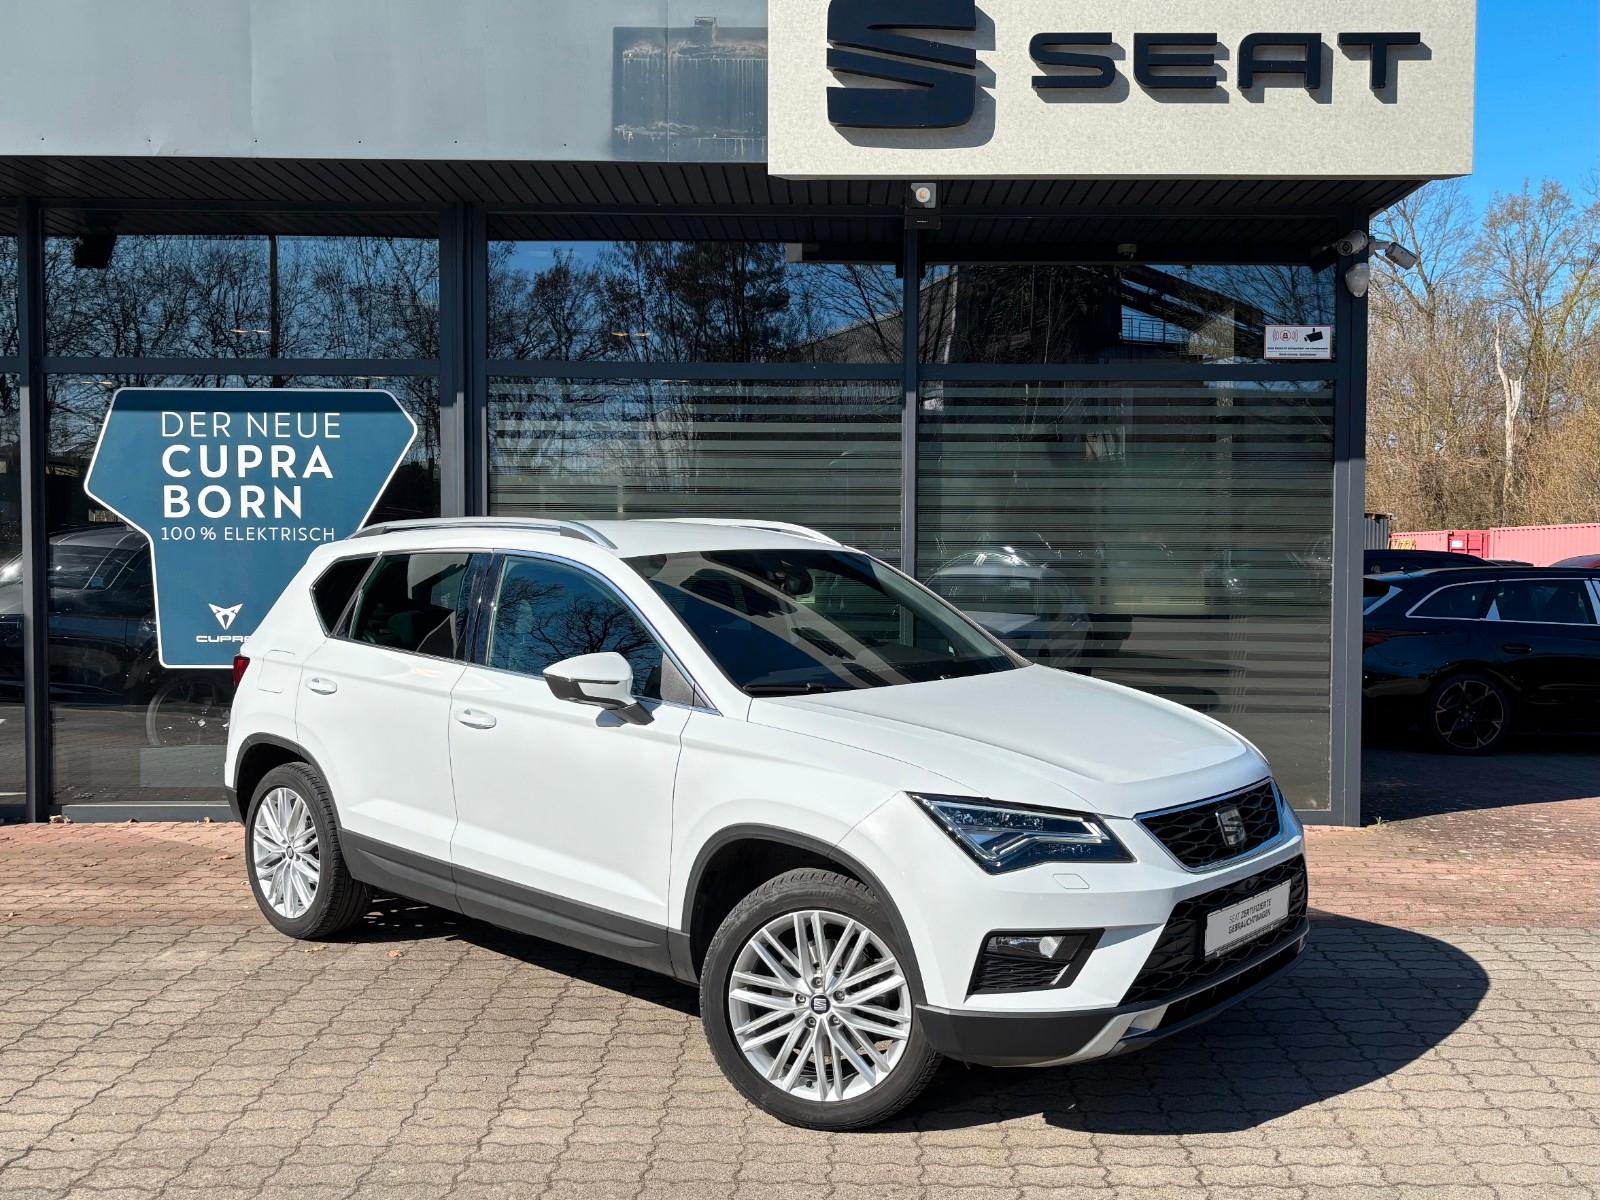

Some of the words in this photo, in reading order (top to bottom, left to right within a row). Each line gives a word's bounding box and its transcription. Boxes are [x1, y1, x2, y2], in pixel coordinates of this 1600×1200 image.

[1029, 32, 1422, 90] SEAT
[161, 411, 231, 438] DER
[247, 412, 341, 439] NEUE
[161, 444, 334, 479] CUPRA
[163, 484, 302, 519] BORN
[161, 526, 196, 541] 100
[224, 527, 335, 542] ELEKTRISCH
